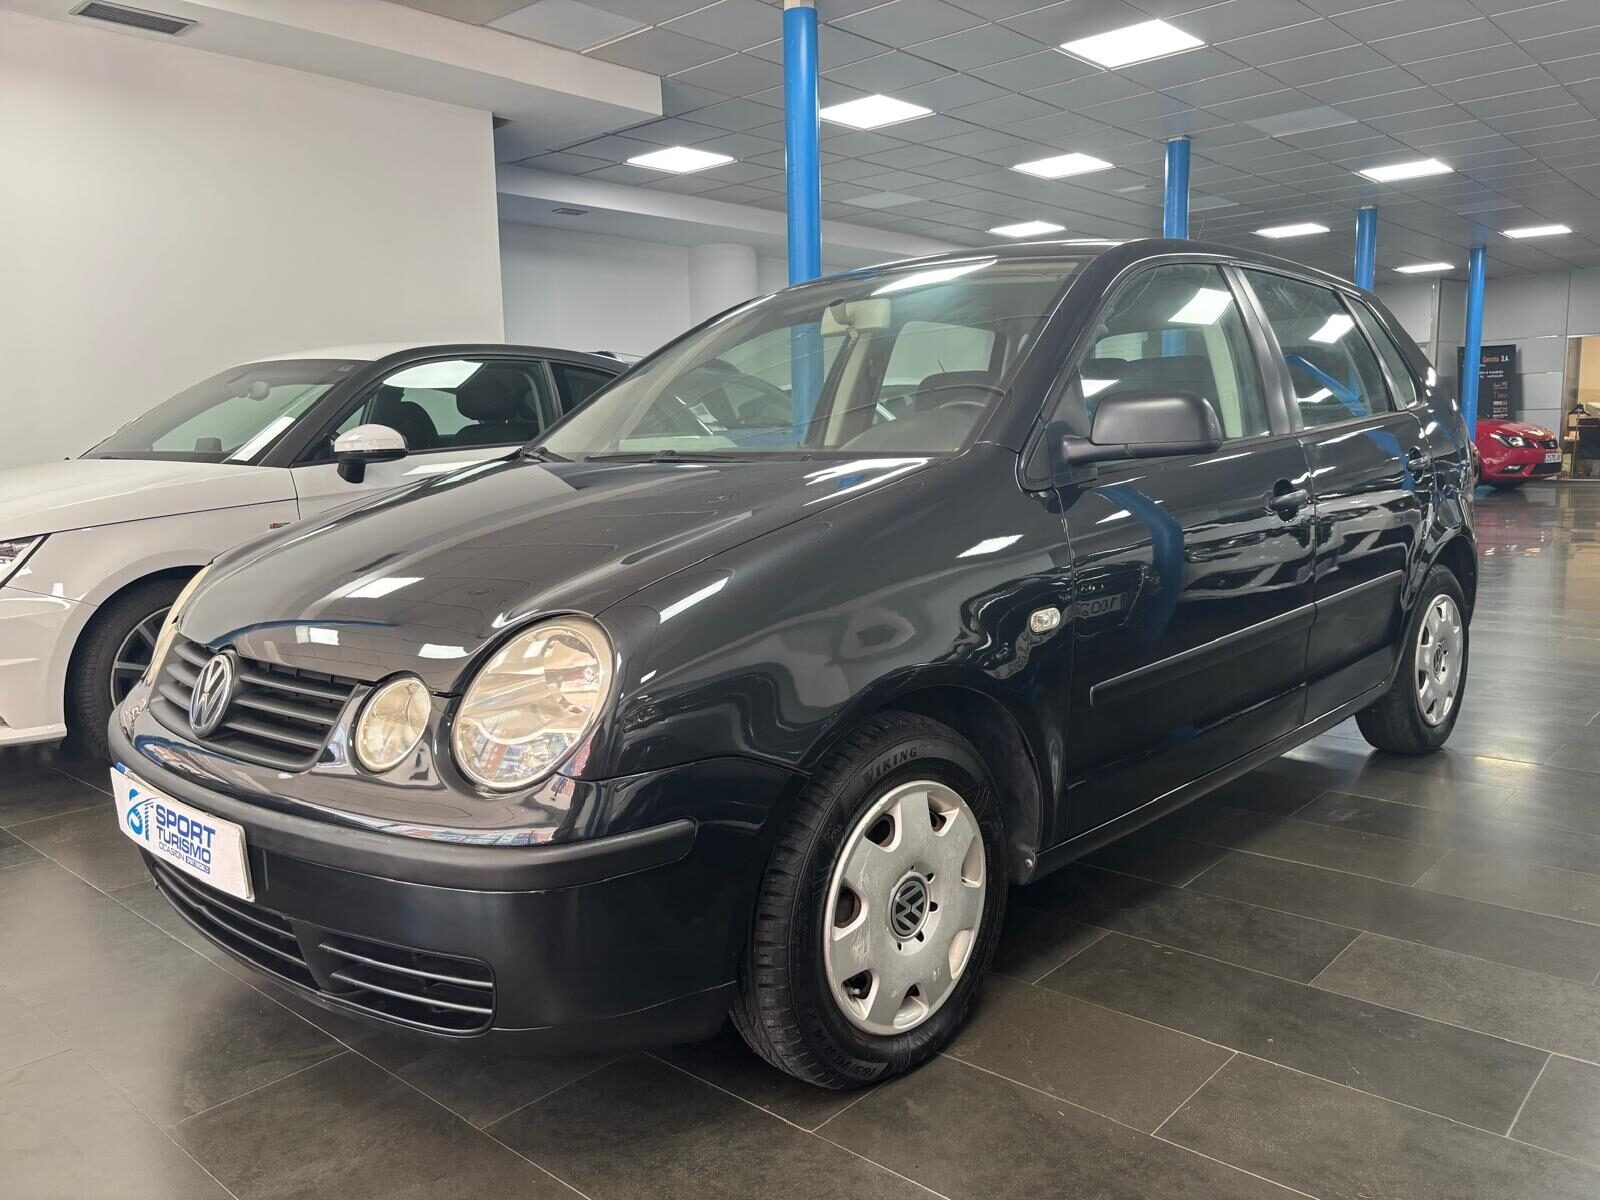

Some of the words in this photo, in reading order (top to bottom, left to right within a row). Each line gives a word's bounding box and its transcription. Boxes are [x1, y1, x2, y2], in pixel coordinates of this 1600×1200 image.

[863, 747, 917, 786] VIKING
[156, 804, 216, 848] SPORT
[156, 825, 212, 865] TURISMO
